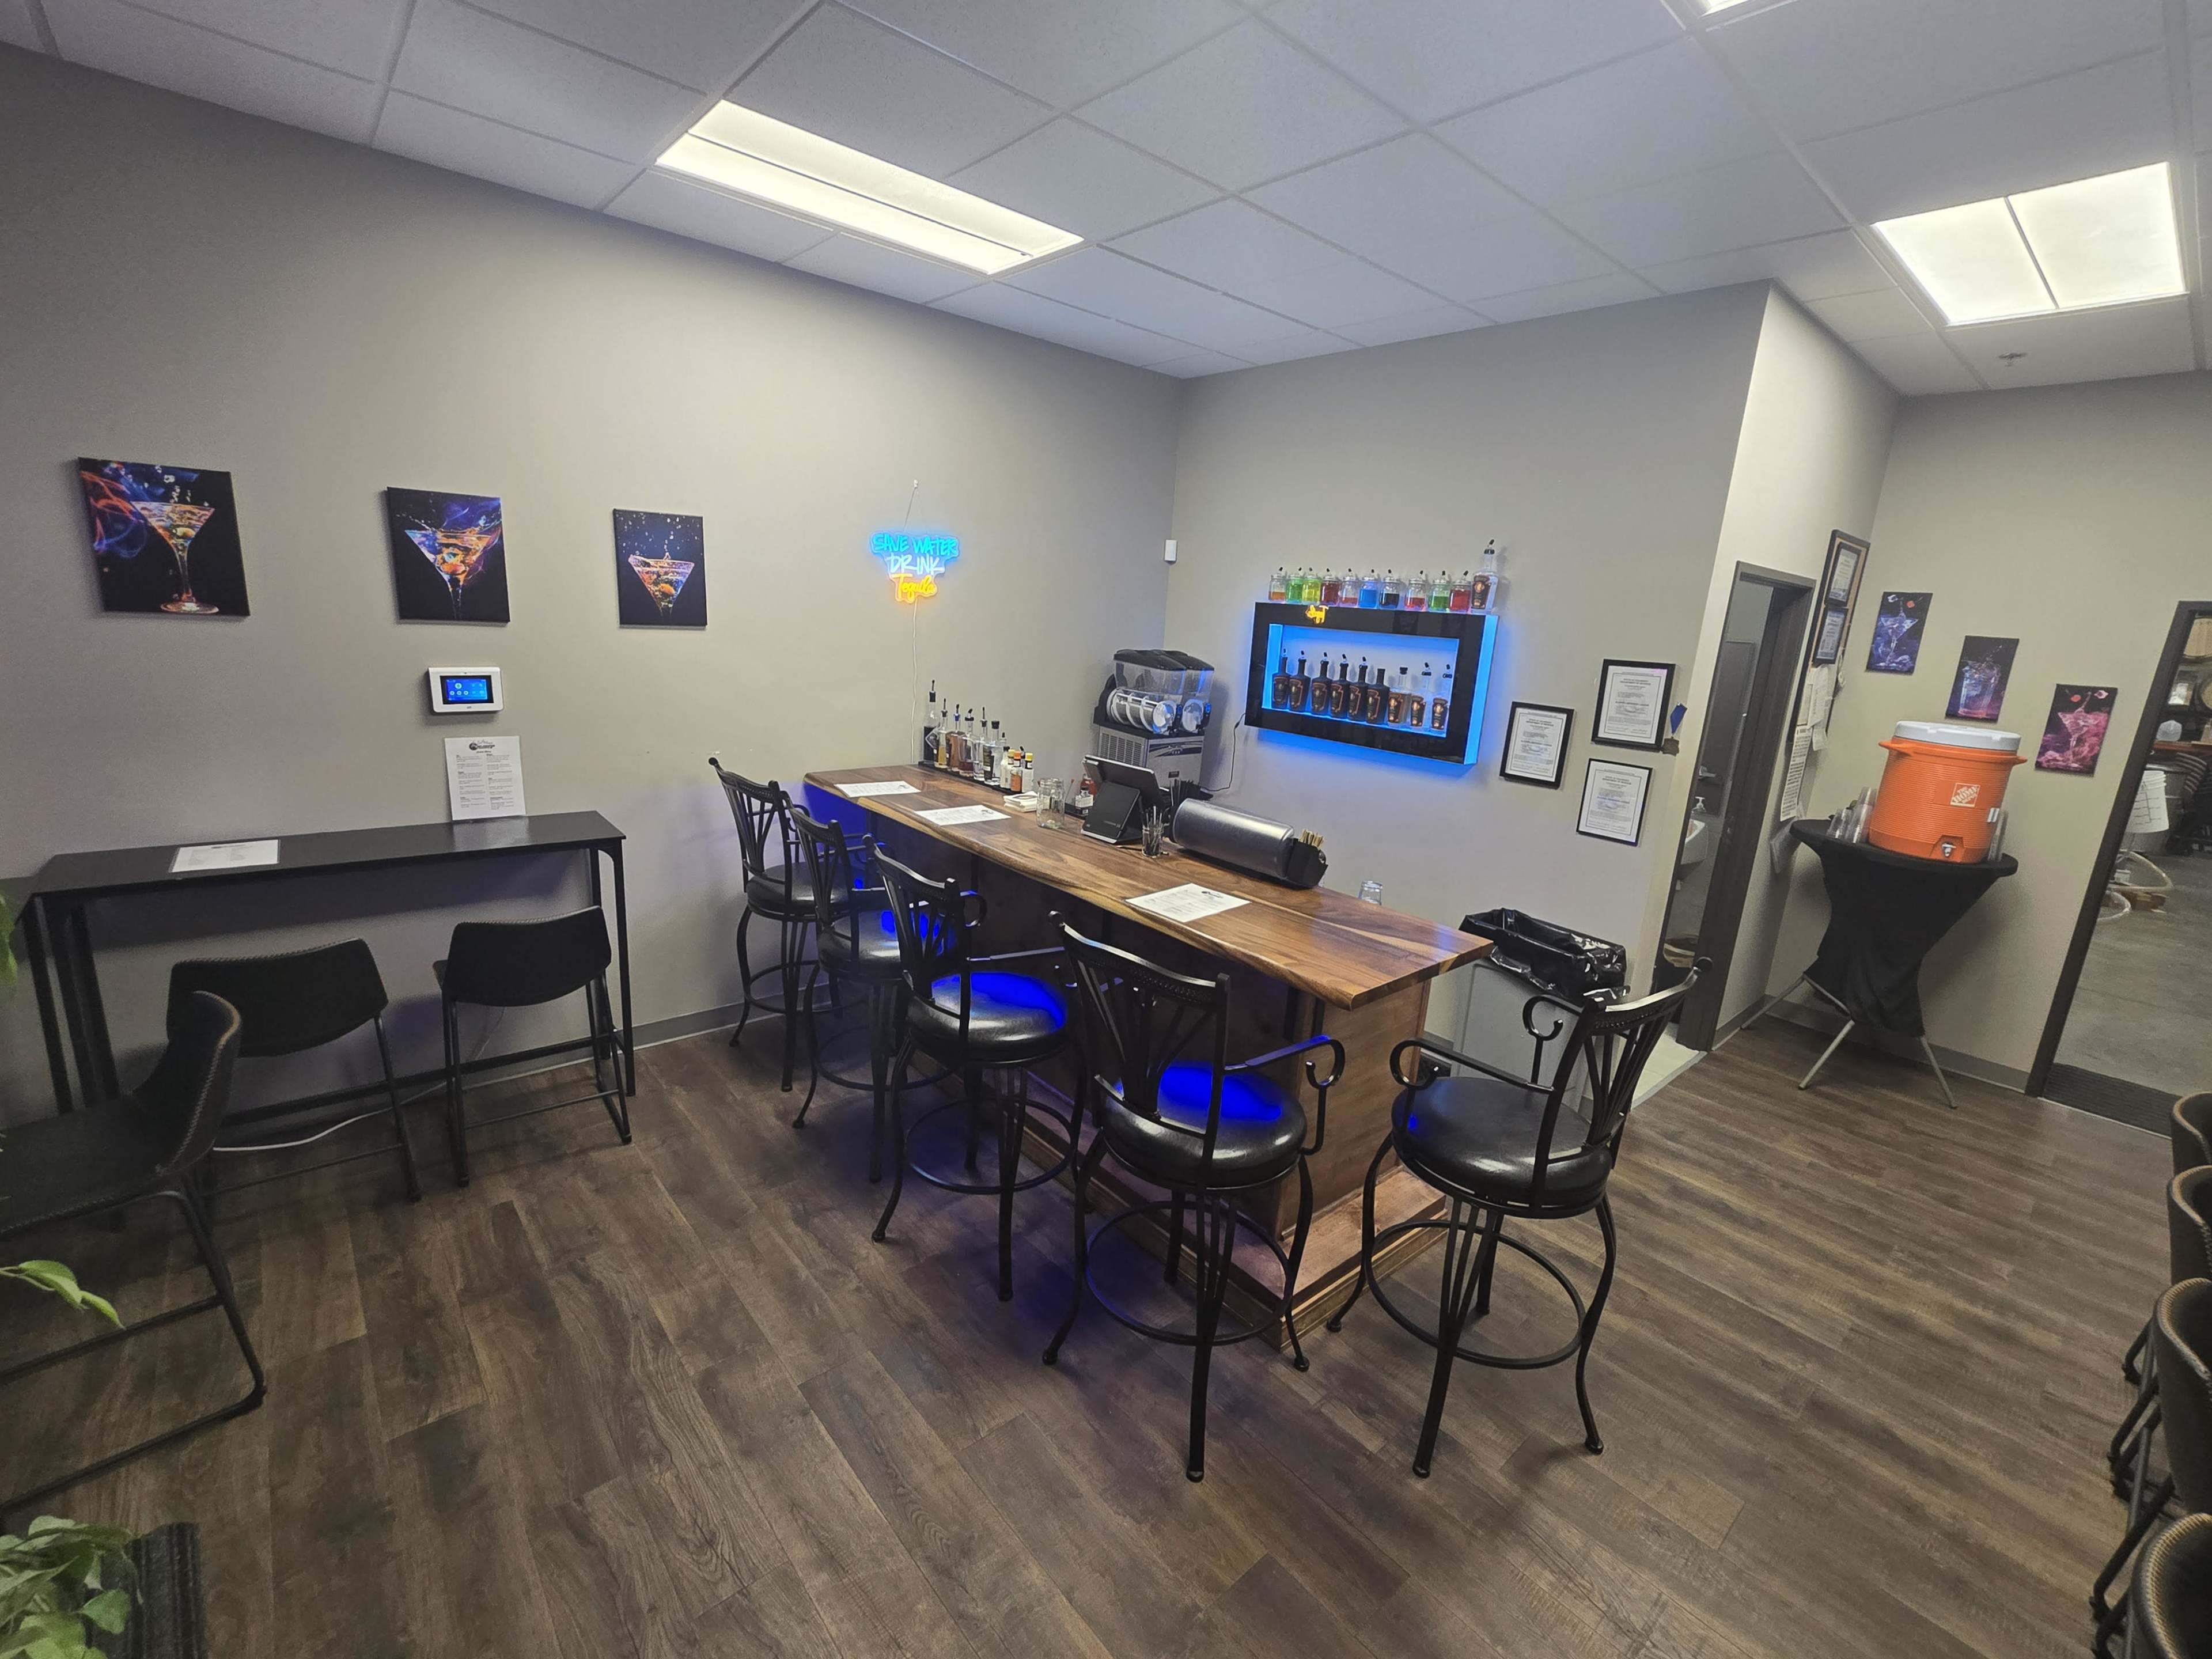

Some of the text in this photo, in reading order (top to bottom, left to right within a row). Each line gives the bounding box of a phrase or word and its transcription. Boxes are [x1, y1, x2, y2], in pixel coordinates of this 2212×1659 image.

[873, 533, 958, 556] SAVE WATER
[885, 552, 945, 575] DRINK
[891, 573, 936, 600] Tequila
[1953, 786, 1977, 803] HOME
